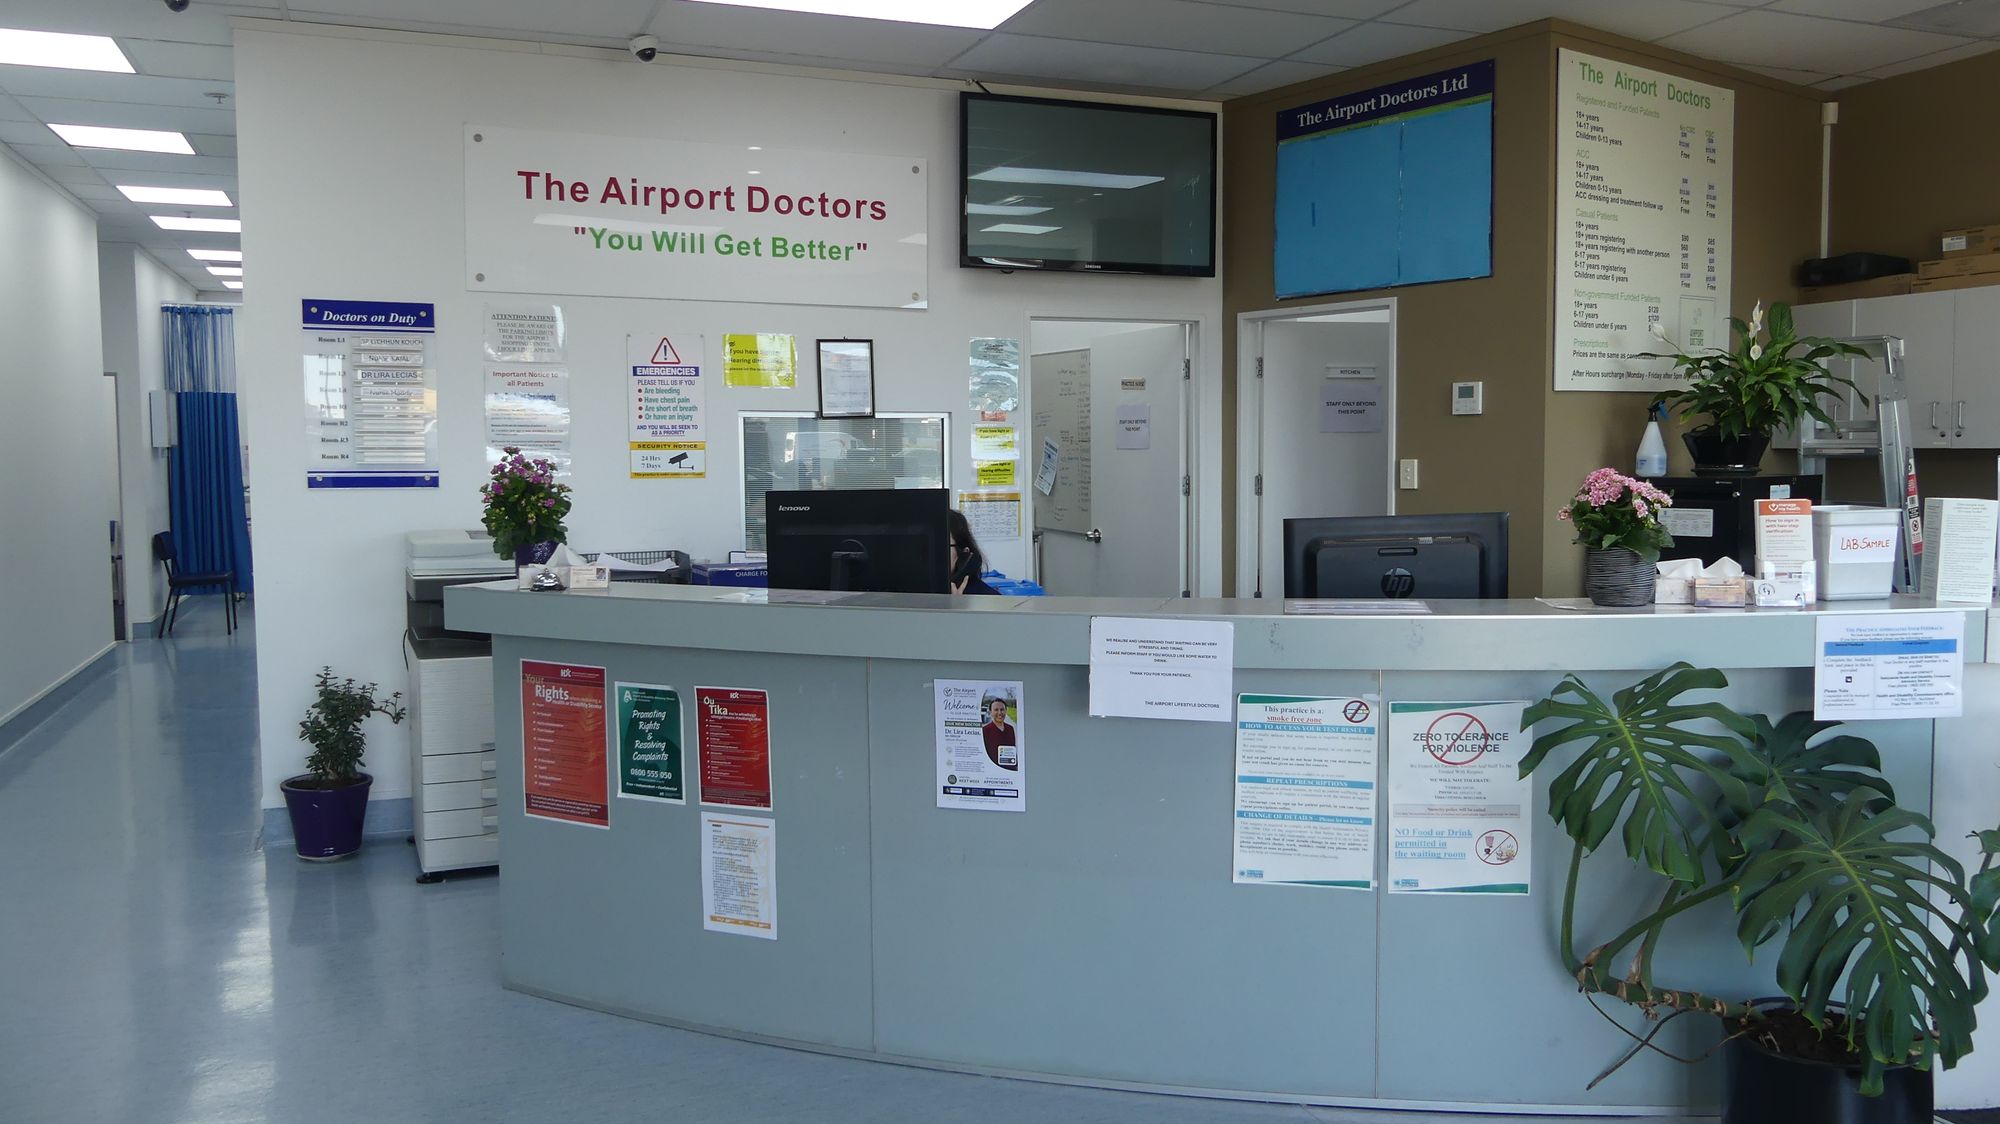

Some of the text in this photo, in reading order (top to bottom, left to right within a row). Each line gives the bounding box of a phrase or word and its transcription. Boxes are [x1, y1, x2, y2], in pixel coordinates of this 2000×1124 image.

[1579, 63, 1711, 109] The Airport Doctors
[1297, 73, 1468, 127] The Airport Doctors Ltd
[1576, 111, 1599, 122] 18+ years
[1576, 121, 1604, 133] 14-17 years
[1575, 130, 1622, 146] Children 0-13 years
[517, 170, 887, 222] The Airport Doctors
[1575, 191, 1586, 199] ACC
[1588, 193, 1609, 204] dressing
[1610, 196, 1619, 204] and
[1620, 197, 1642, 207] treatment
[1643, 200, 1656, 209] follow
[574, 226, 868, 262] "You Will Get Better"
[1574, 300, 1583, 308] 18+
[1584, 302, 1597, 310] years
[322, 311, 417, 325] Doctors on Duty
[1573, 310, 1584, 318] 6-17
[1585, 312, 1598, 320] years
[1573, 350, 1588, 358] Prices
[361, 371, 373, 379] DR
[493, 371, 527, 379] Important
[637, 368, 696, 376] EMERGENCIES
[1585, 370, 1600, 378] Hours
[1601, 371, 1624, 380] surcharge
[1648, 371, 1662, 380] Friday
[655, 388, 680, 396] bleeding
[677, 397, 690, 405] pain
[1840, 537, 1890, 551] LAB SAMPLE
[525, 673, 544, 684] Your
[535, 684, 569, 703] Rights
[944, 698, 975, 710] Welcome
[708, 704, 728, 715] Tika
[1280, 707, 1308, 715] practice
[632, 709, 667, 721] Promoting
[638, 721, 660, 733] Rights
[1412, 732, 1509, 742] ZERO TOLERANCE
[634, 740, 666, 751] Resolving
[1422, 744, 1500, 753] FOR VIOLENCE
[632, 752, 669, 763] Complaints
[630, 768, 646, 776] 0800
[647, 769, 659, 778] 555
[1294, 779, 1348, 787] PRESCRIPTIONS
[1284, 813, 1313, 821] DETAILS
[1395, 828, 1410, 836] NO
[1412, 828, 1434, 836] Food
[1448, 828, 1473, 836] Drink
[1395, 839, 1447, 848] permitted in
[1410, 850, 1441, 860] waiting
